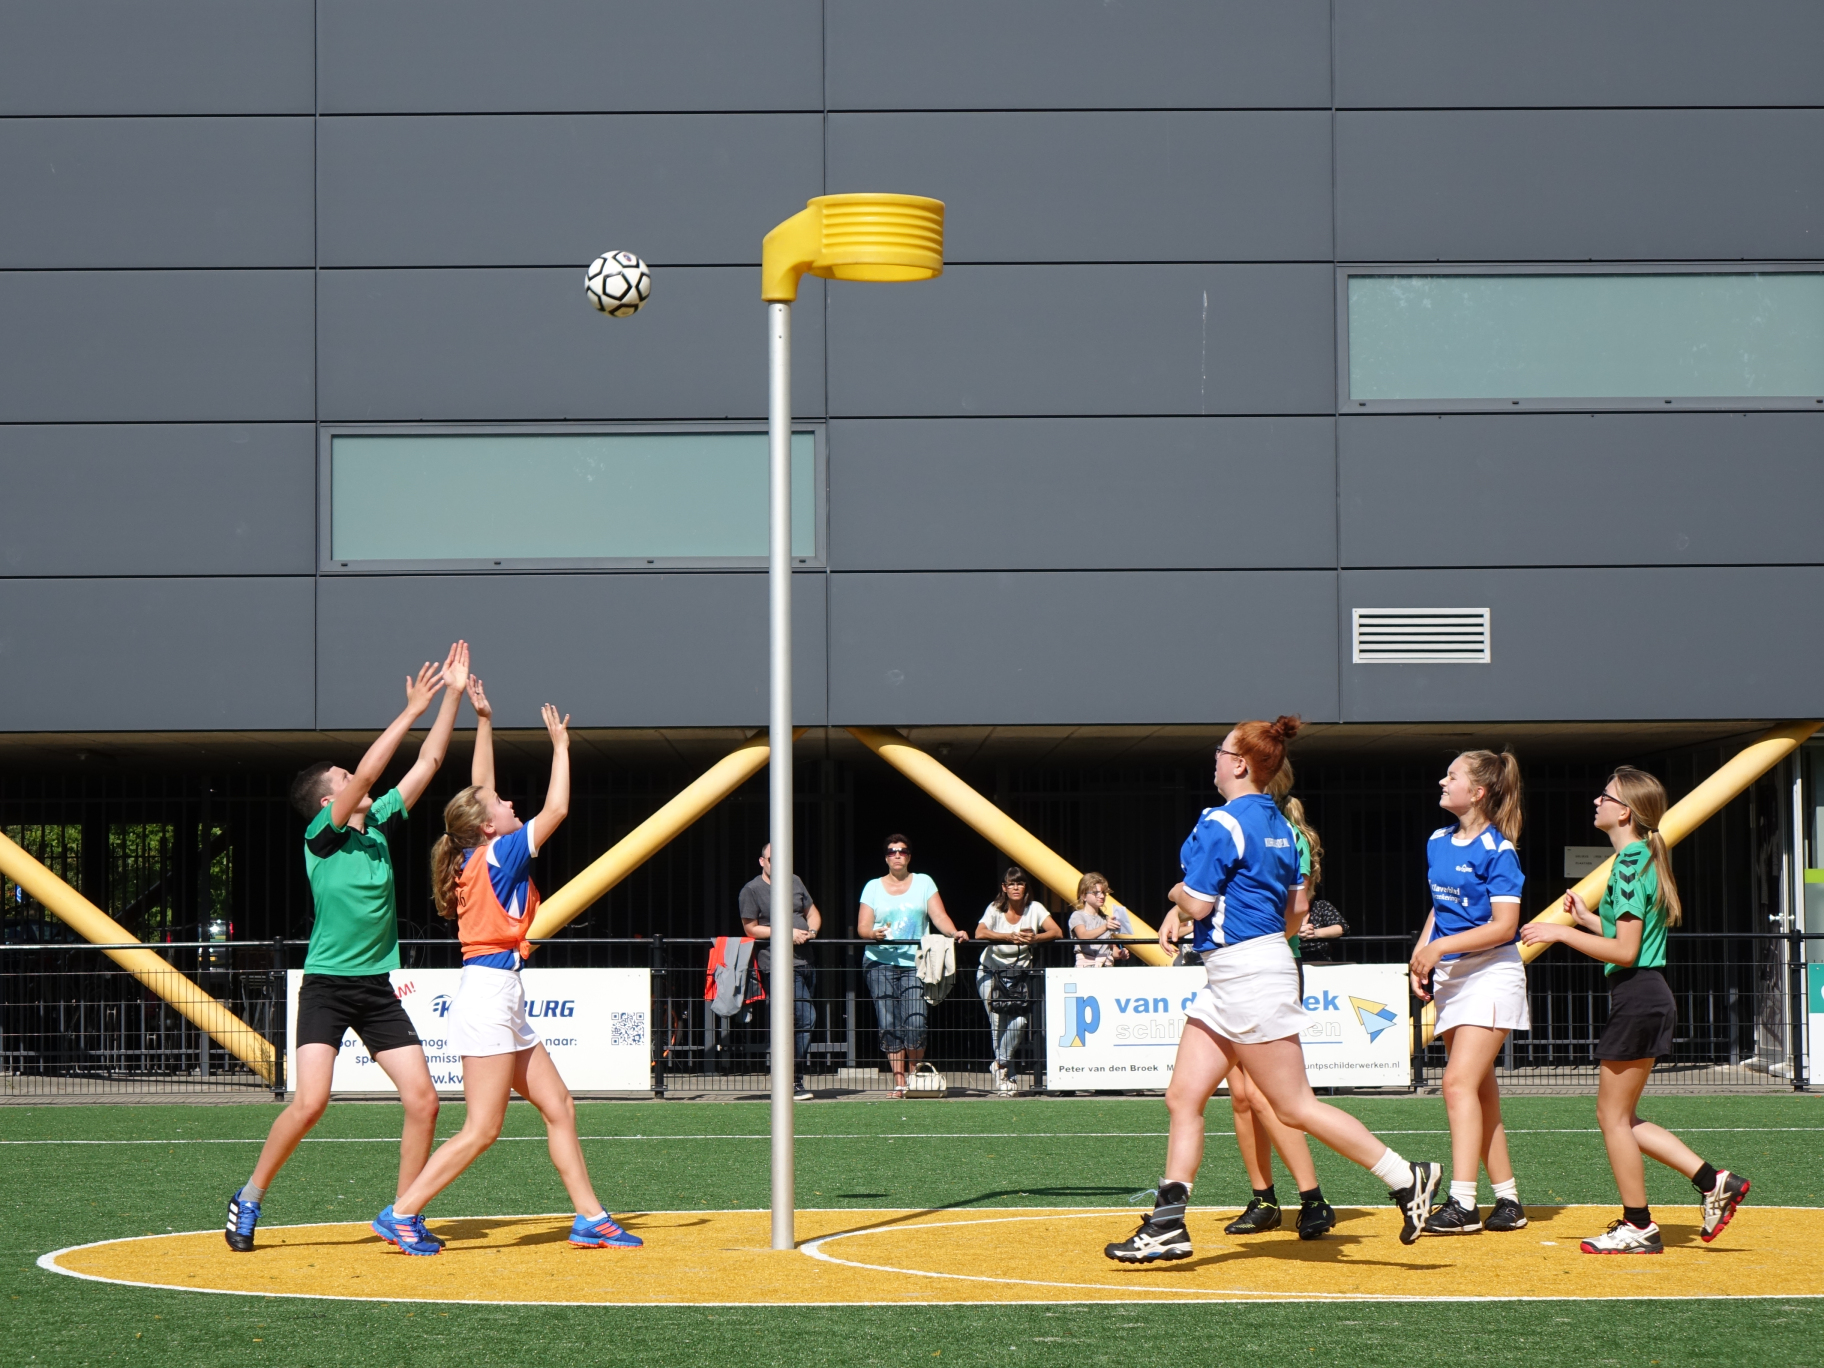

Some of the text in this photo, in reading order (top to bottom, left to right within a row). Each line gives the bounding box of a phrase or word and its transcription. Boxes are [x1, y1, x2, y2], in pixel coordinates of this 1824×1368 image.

[1115, 997, 1169, 1014] van
[1059, 983, 1100, 1048] jp
[545, 1038, 578, 1046] naar:
[1058, 1064, 1086, 1073] Peter
[1108, 1064, 1127, 1072] den
[1130, 1064, 1159, 1072] Broek
